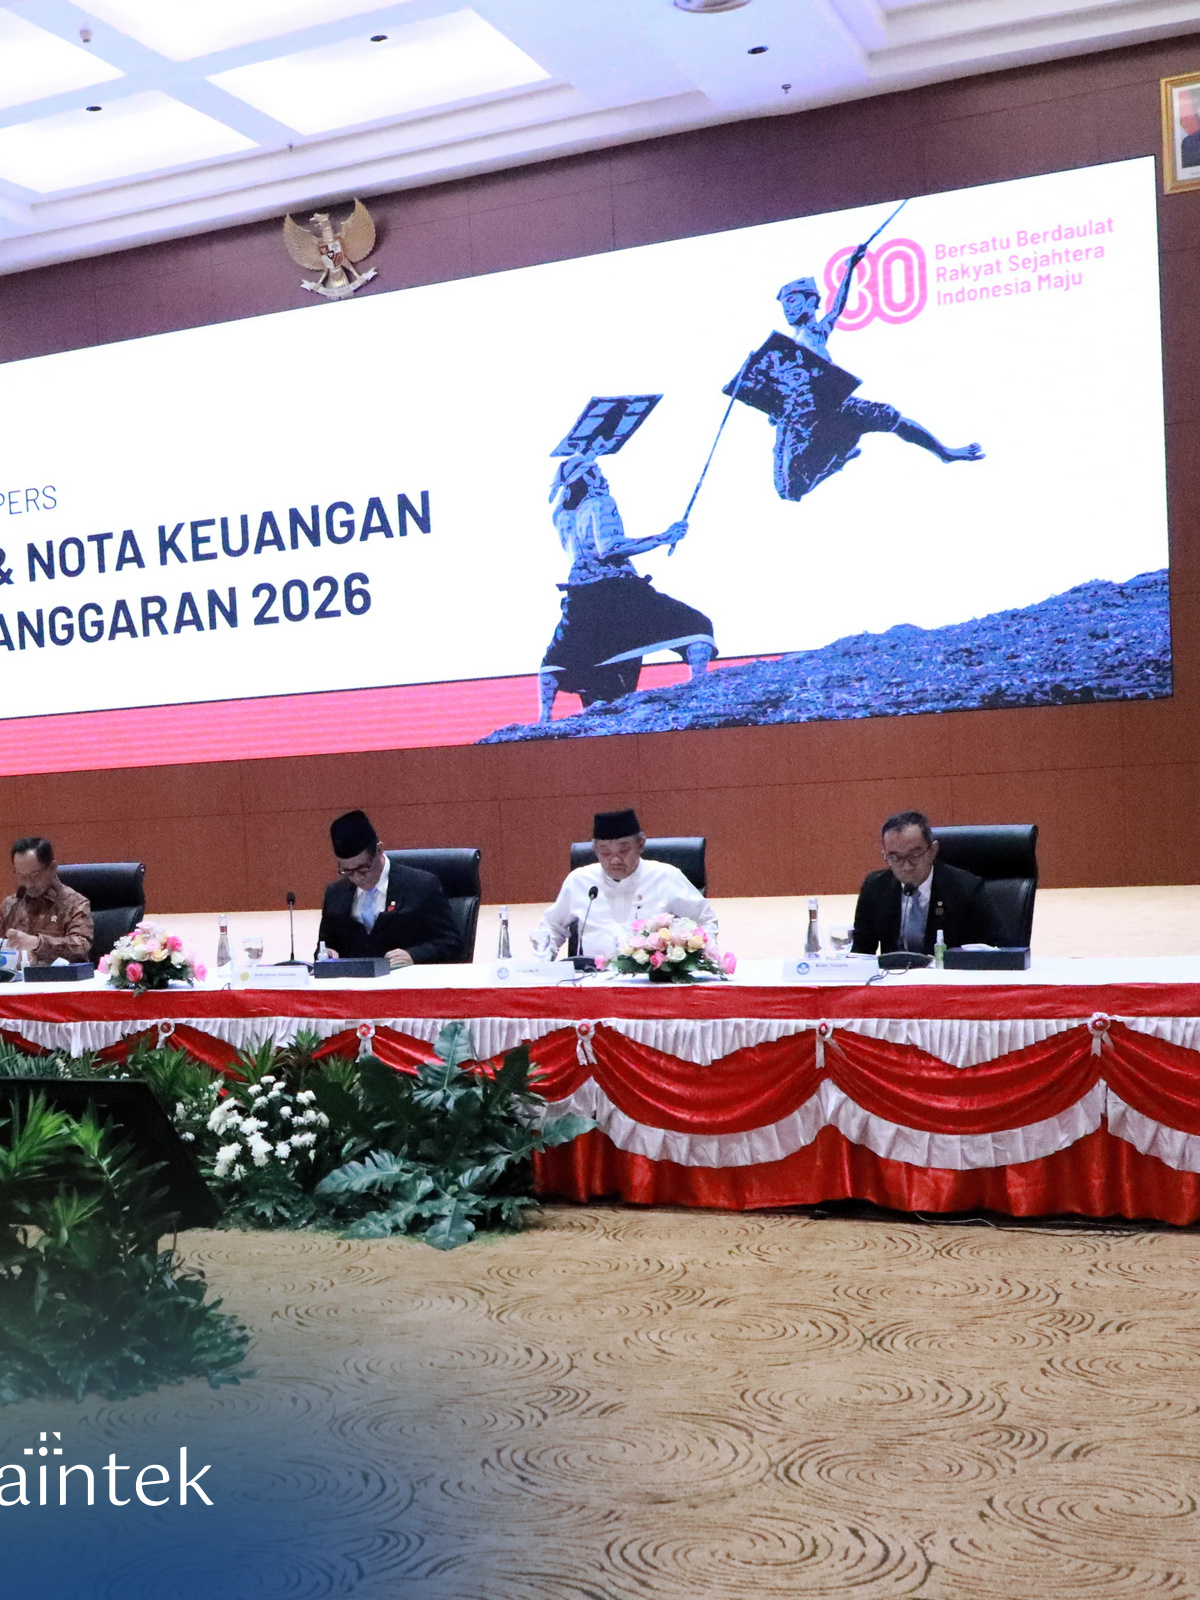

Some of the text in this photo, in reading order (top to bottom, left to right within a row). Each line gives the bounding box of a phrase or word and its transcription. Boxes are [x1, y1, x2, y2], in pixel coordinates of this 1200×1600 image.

[935, 217, 1114, 260] Bersatu Berdaulat
[823, 237, 928, 332] 80
[936, 245, 1105, 283] Rakyat Sejahtera
[936, 269, 1083, 306] Indonesia Maju
[26, 529, 146, 583] NOTA
[157, 490, 431, 566] KEUANGAN
[251, 572, 372, 626] 2026
